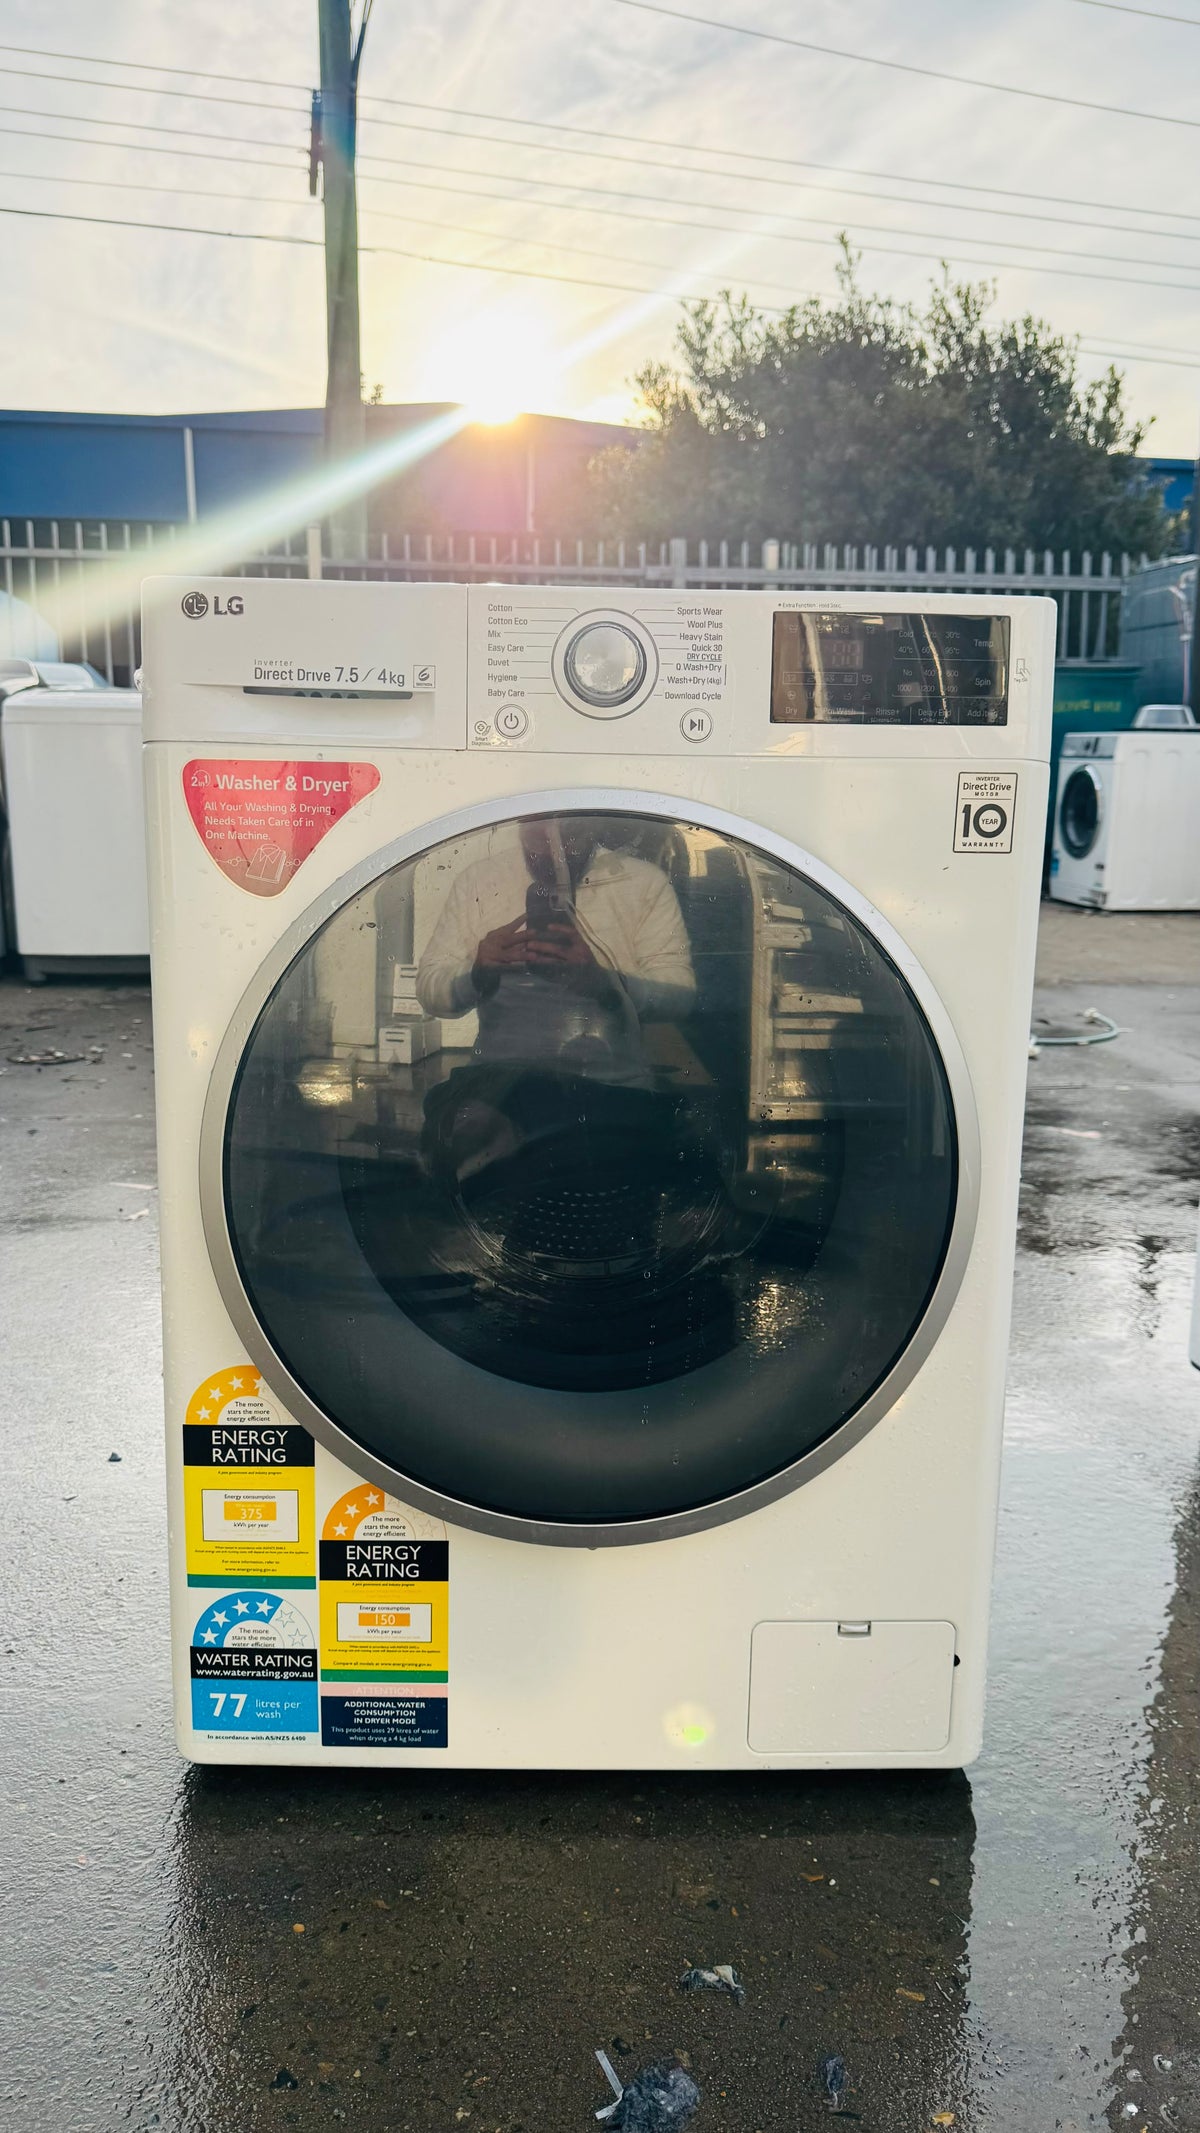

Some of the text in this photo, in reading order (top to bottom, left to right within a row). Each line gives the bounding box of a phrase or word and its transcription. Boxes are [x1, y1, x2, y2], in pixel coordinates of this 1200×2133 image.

[214, 596, 244, 615] LG
[488, 604, 512, 612] Cotton
[677, 607, 723, 616] Sports Wear
[488, 617, 528, 625] Cotton Eco
[688, 620, 723, 629] Wool Plus
[488, 630, 501, 638] Mix
[680, 633, 722, 642] Heavy Stain
[692, 644, 722, 652] Quick 30
[973, 639, 993, 648] Temp
[488, 644, 524, 653] Easy Care
[254, 659, 294, 667] inverter
[488, 658, 509, 666] Duvet
[254, 668, 293, 681] Direct
[298, 669, 331, 682] Drive
[335, 667, 359, 682] 7.5
[488, 673, 518, 682] Hygiene
[667, 676, 722, 686] Wash+Dry (4kg)
[975, 678, 991, 688] Spin
[488, 689, 524, 698] Baby Care
[665, 692, 721, 701] Download Cycle
[785, 706, 798, 715] Dry
[216, 775, 280, 790] Washer
[285, 776, 297, 790] &
[303, 776, 349, 795] Dryer
[205, 803, 331, 815] All Your Washing & Drying
[205, 816, 314, 826] Needs Taken Care of in
[962, 803, 1007, 838] 10
[205, 831, 270, 840] One Machine.
[212, 1430, 288, 1445] ENERGY
[212, 1448, 286, 1462] RATING
[241, 1508, 263, 1520] 375
[347, 1545, 421, 1560] ENERGY
[347, 1564, 420, 1578] RATING
[375, 1615, 396, 1625] 150
[197, 1653, 312, 1667] WATER RATING
[197, 1669, 314, 1679] www.waterrating.gov.au
[209, 1693, 301, 1718] 77 litres per
[256, 1710, 281, 1719] wash
